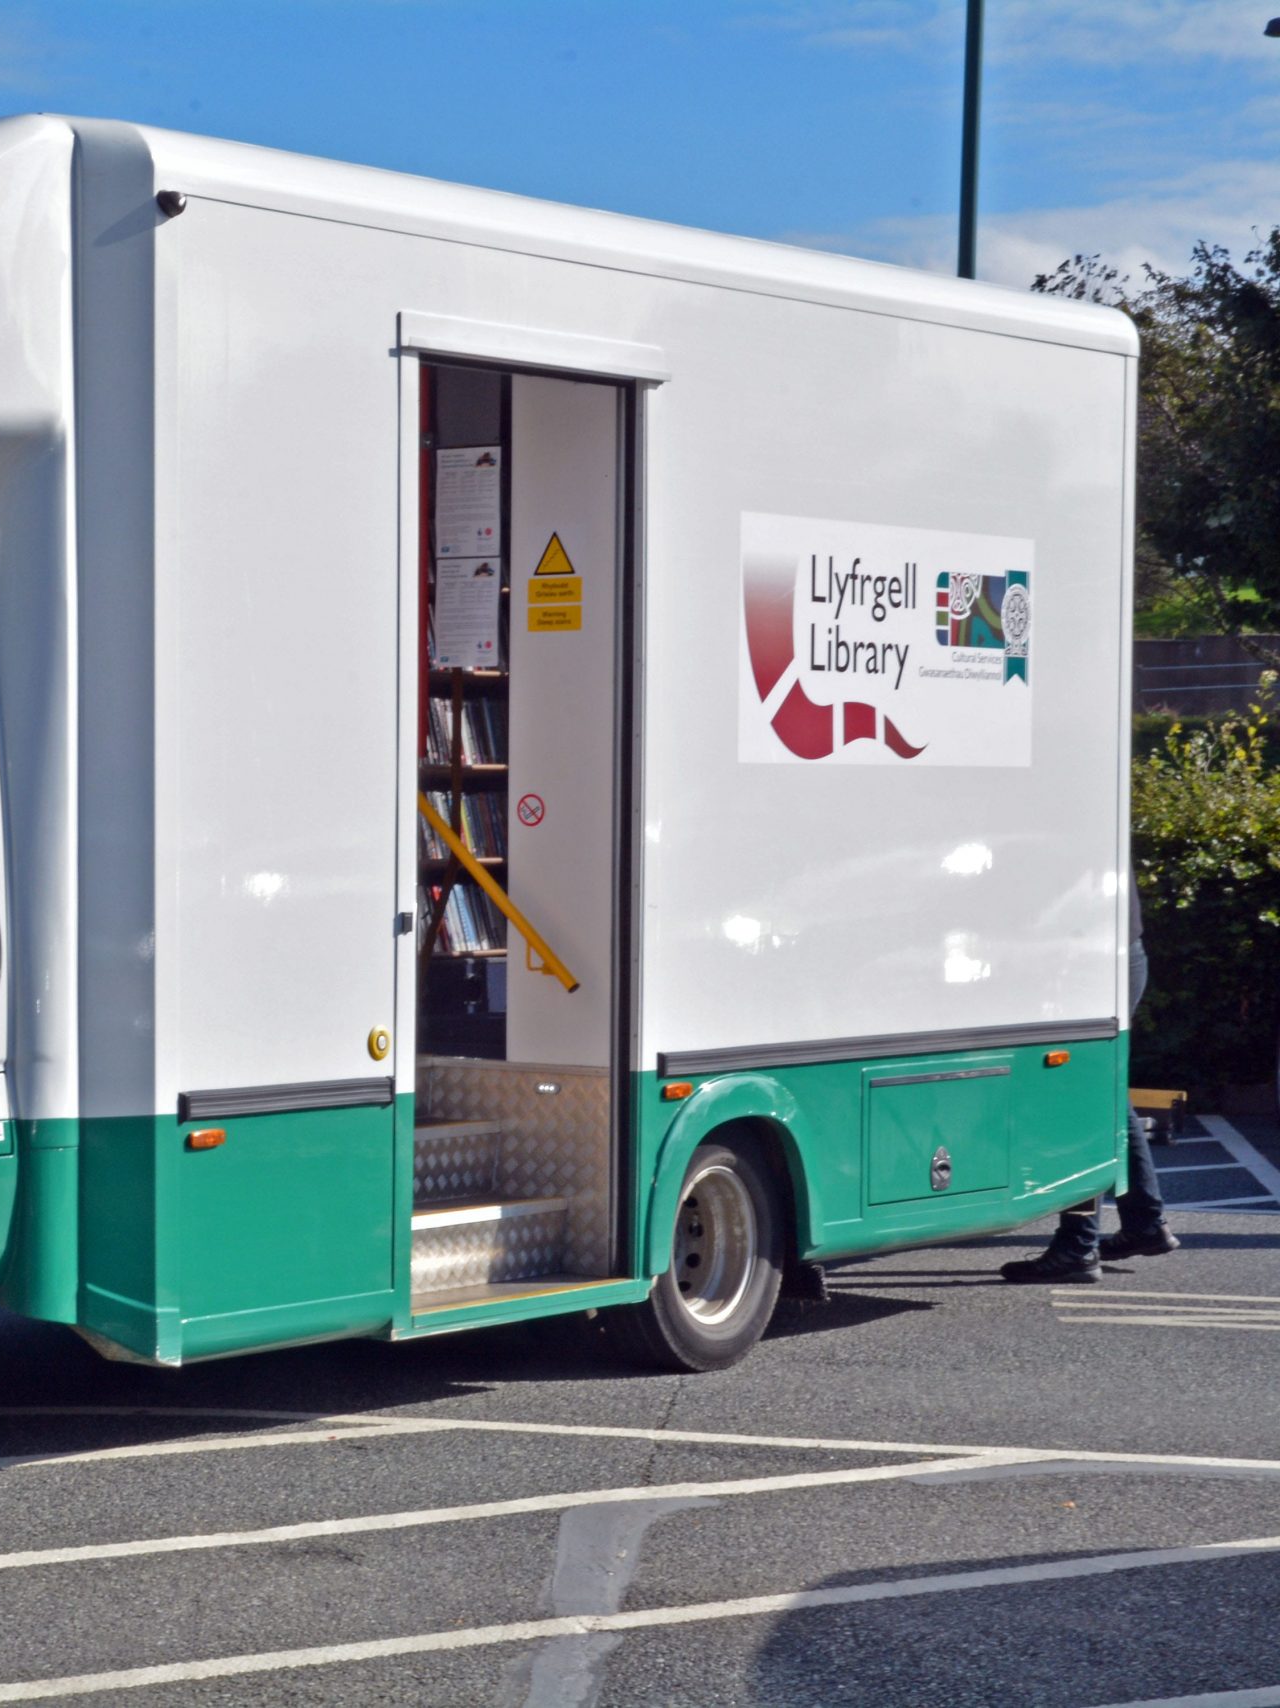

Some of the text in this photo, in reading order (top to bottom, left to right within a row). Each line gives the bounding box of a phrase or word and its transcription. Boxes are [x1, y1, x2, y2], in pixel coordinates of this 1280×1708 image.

[810, 553, 918, 623] Llyfrgell
[809, 622, 910, 691] Library
[951, 651, 1002, 665] Cultural Services
